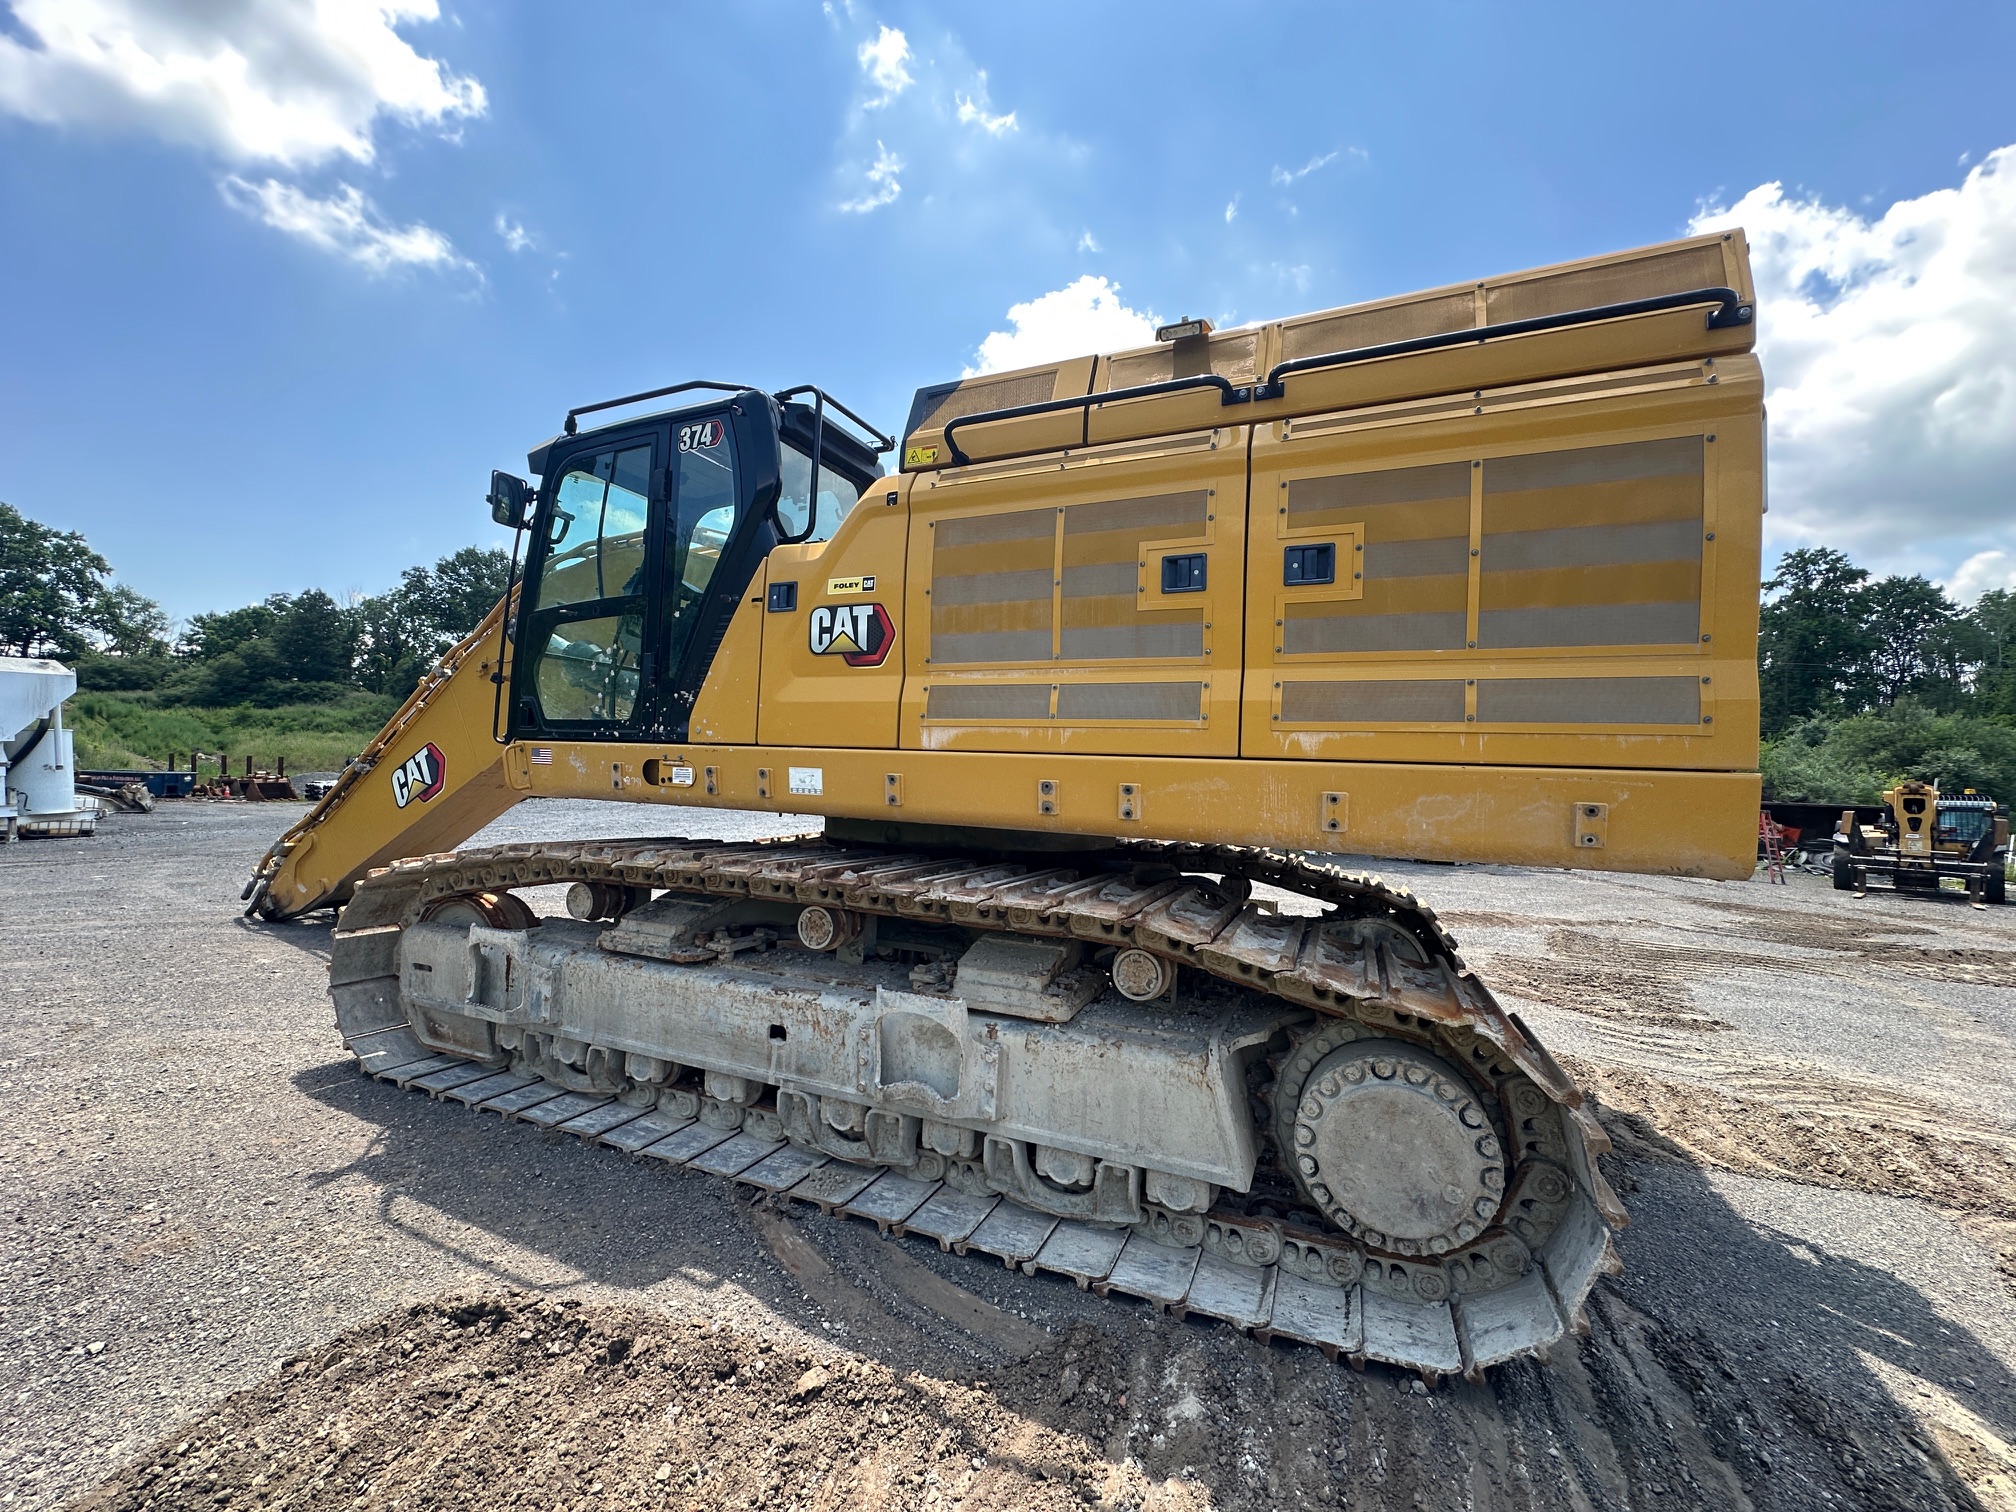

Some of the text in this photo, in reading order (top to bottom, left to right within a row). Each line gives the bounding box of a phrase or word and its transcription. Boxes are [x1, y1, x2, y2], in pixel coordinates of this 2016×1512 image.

[680, 422, 712, 451] 374
[810, 604, 874, 654] CAT
[391, 746, 432, 808] CAT
